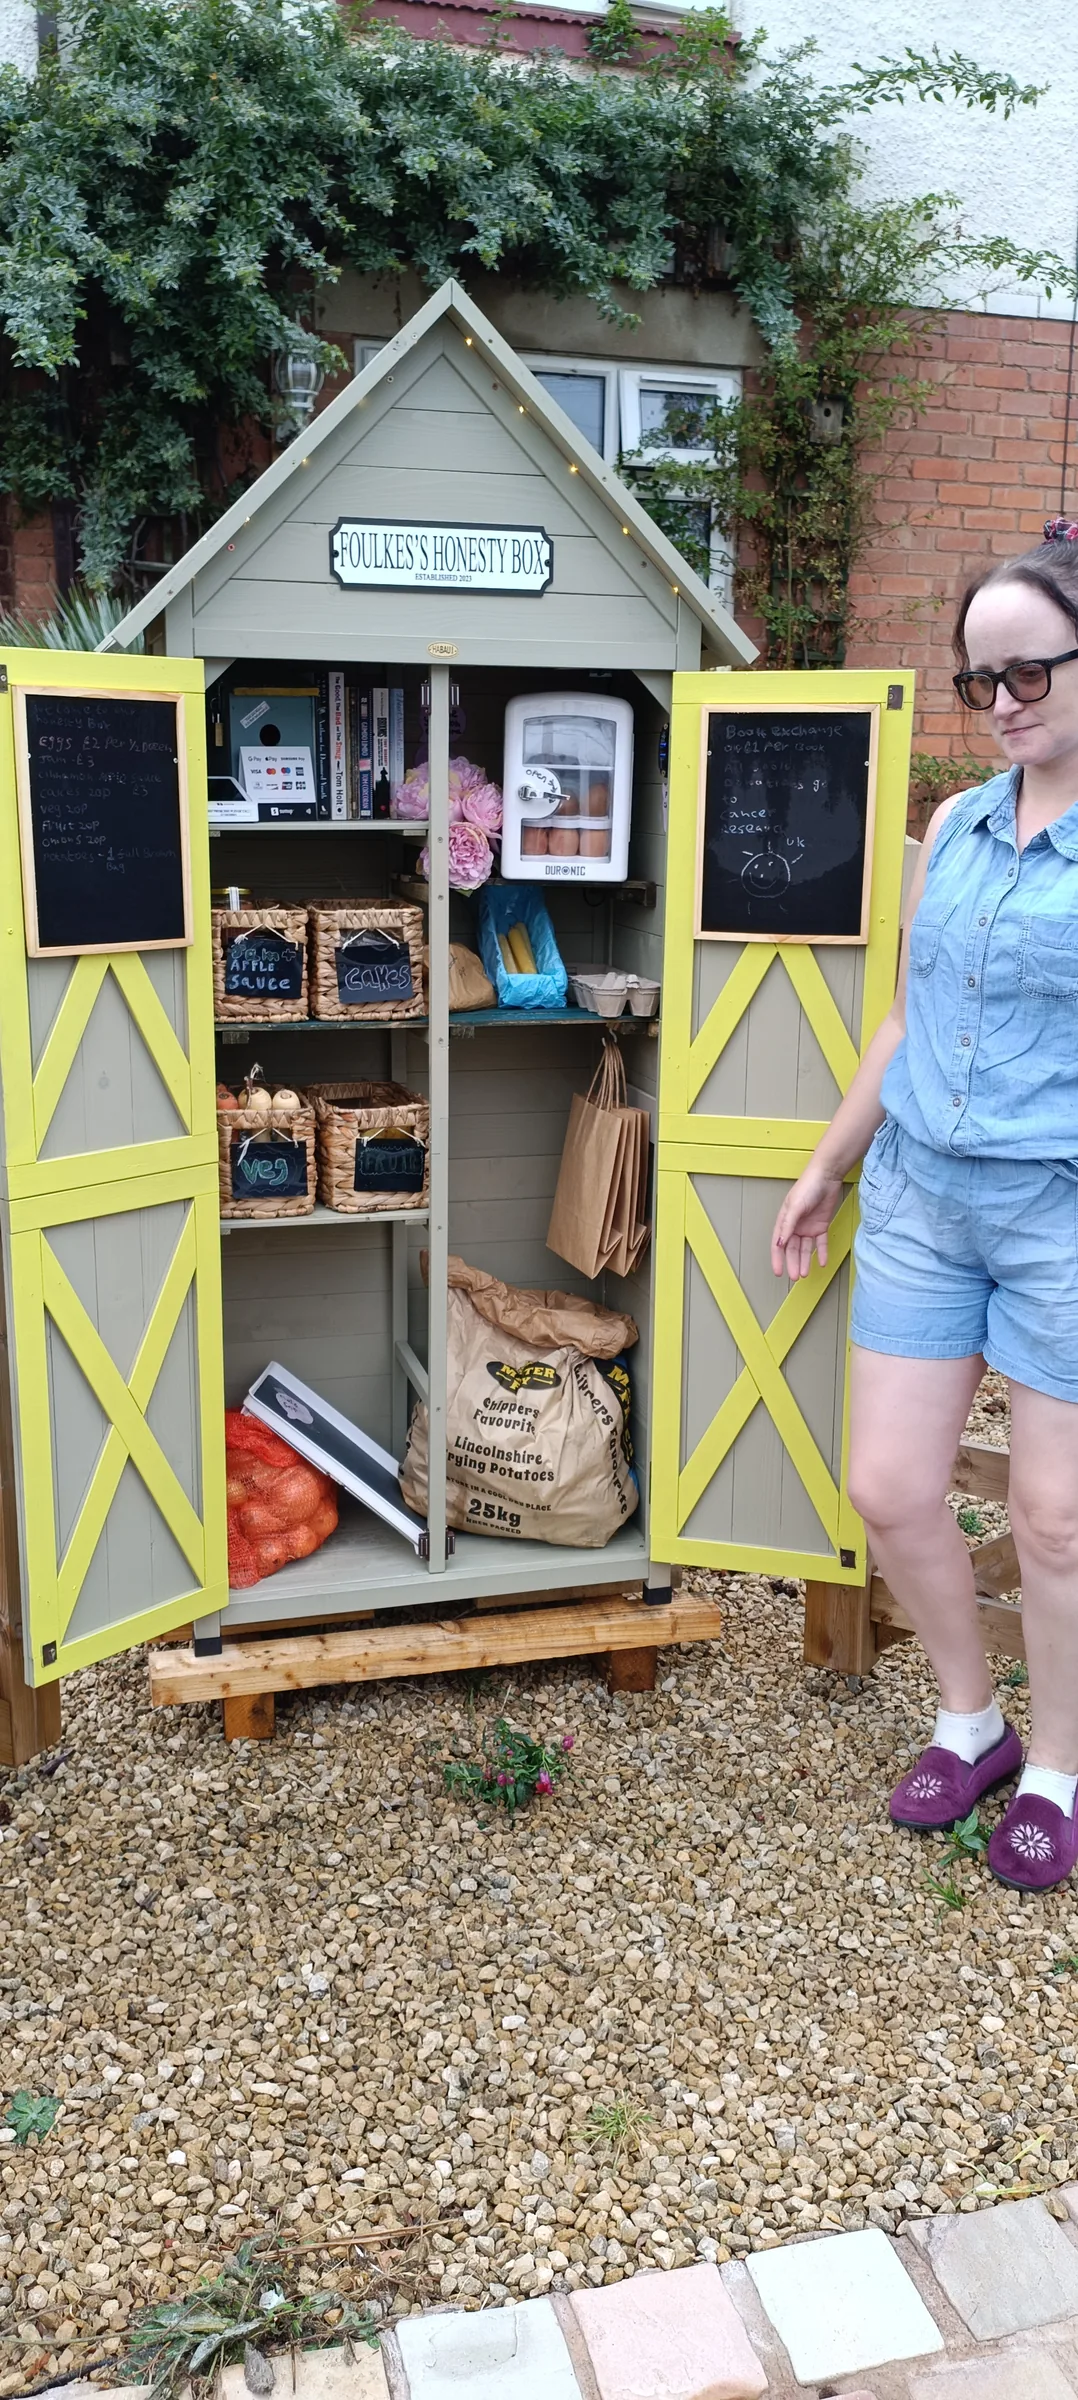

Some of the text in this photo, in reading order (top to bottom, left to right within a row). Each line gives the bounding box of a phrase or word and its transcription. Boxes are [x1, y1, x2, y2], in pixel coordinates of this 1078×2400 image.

[340, 532, 544, 574] FOULKES'S HONESTY BOX
[415, 573, 458, 582] ESTABLISHED
[334, 741, 342, 760] Smug
[335, 771, 343, 787] Tom
[721, 795, 738, 804] to
[482, 1397, 540, 1419] Chippers
[473, 1408, 537, 1436] Favourite
[454, 1435, 543, 1465] Lincolnshire
[446, 1449, 555, 1482] rying Potatoes
[470, 1484, 480, 1492] IN
[487, 1490, 507, 1501] COOL
[525, 1503, 552, 1512] PLACE
[468, 1498, 522, 1528] 25kg
[490, 1523, 522, 1535] PACKED
